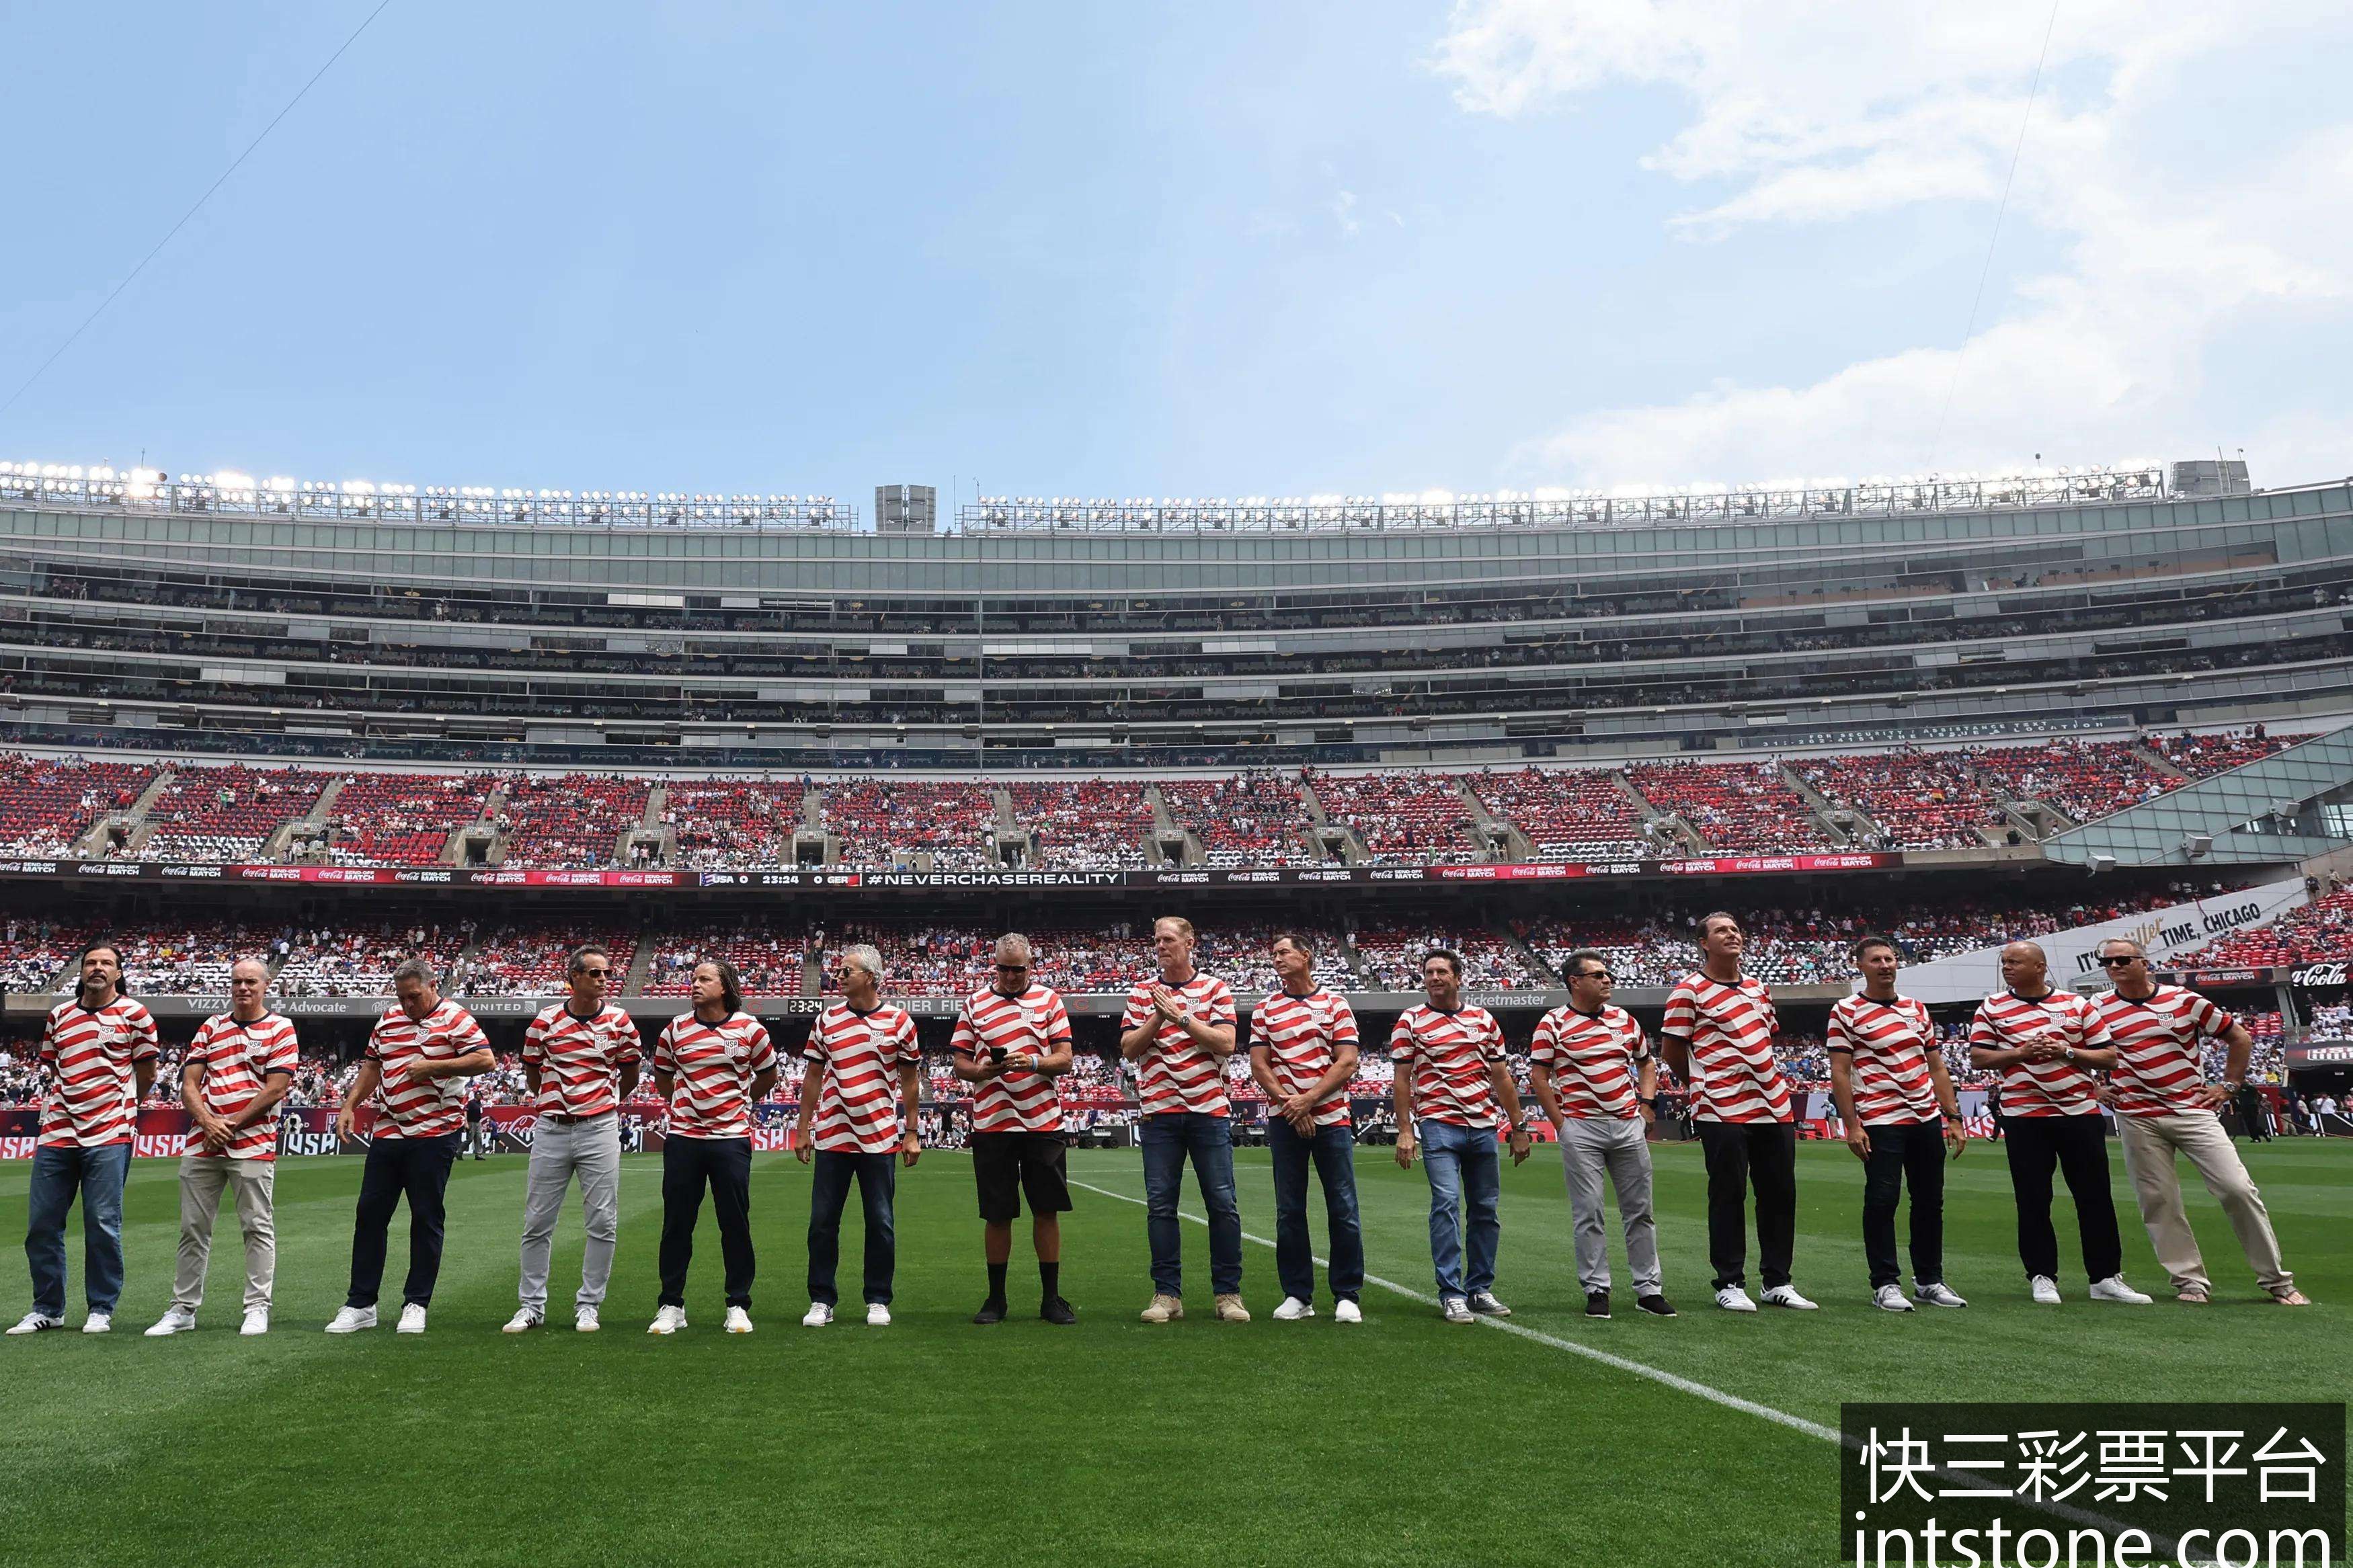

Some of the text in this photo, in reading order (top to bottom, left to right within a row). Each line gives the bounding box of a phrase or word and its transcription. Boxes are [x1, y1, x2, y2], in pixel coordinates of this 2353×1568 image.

[1840, 730, 1903, 738] SECURITY
[1923, 724, 2005, 733] ASSISTANCE
[2013, 722, 2104, 733] LOCATION
[1737, 860, 1761, 869] Coca-Cola
[1814, 858, 1839, 866] Coca-Cola
[79, 864, 106, 873] Coca-Cola
[161, 866, 188, 876] Coca-Cola
[1513, 868, 1536, 876] Coca-Cola
[1586, 865, 1609, 874] Coca-Cola
[1660, 863, 1683, 872] Coca-Cola
[243, 868, 268, 878] Coca-Cola
[319, 870, 344, 879] Coca-Cola
[395, 872, 420, 880] Coca-Cola
[471, 873, 495, 882] Coca-Cola
[1228, 873, 1250, 881] Coca-Cola
[1299, 872, 1321, 880] Coca-Cola
[1370, 870, 1393, 879] Coca-Cola
[1442, 869, 1465, 878] Coca-Cola
[546, 874, 570, 882] Coca-Cola
[619, 874, 643, 883] Coca-Cola
[713, 876, 733, 884] USA
[762, 875, 799, 884] 23:24
[828, 876, 848, 884] GER
[867, 874, 1119, 885] #NEVERCHASEREALITY
[1158, 874, 1180, 882] Coca-Cola
[2159, 922, 2201, 947] TIME,
[2203, 903, 2261, 934] CHICAGO
[2291, 962, 2348, 987] a-Cola
[1464, 993, 1547, 1005] ticketmaster
[187, 999, 231, 1009] VIZZY
[288, 1001, 346, 1013] Advocate
[790, 1000, 823, 1013] 23:24
[895, 1000, 964, 1012] DIER FIE
[288, 1134, 336, 1155] USA
[754, 1129, 784, 1151] SA
[0, 1137, 36, 1159] SA
[138, 1134, 187, 1157] USA
